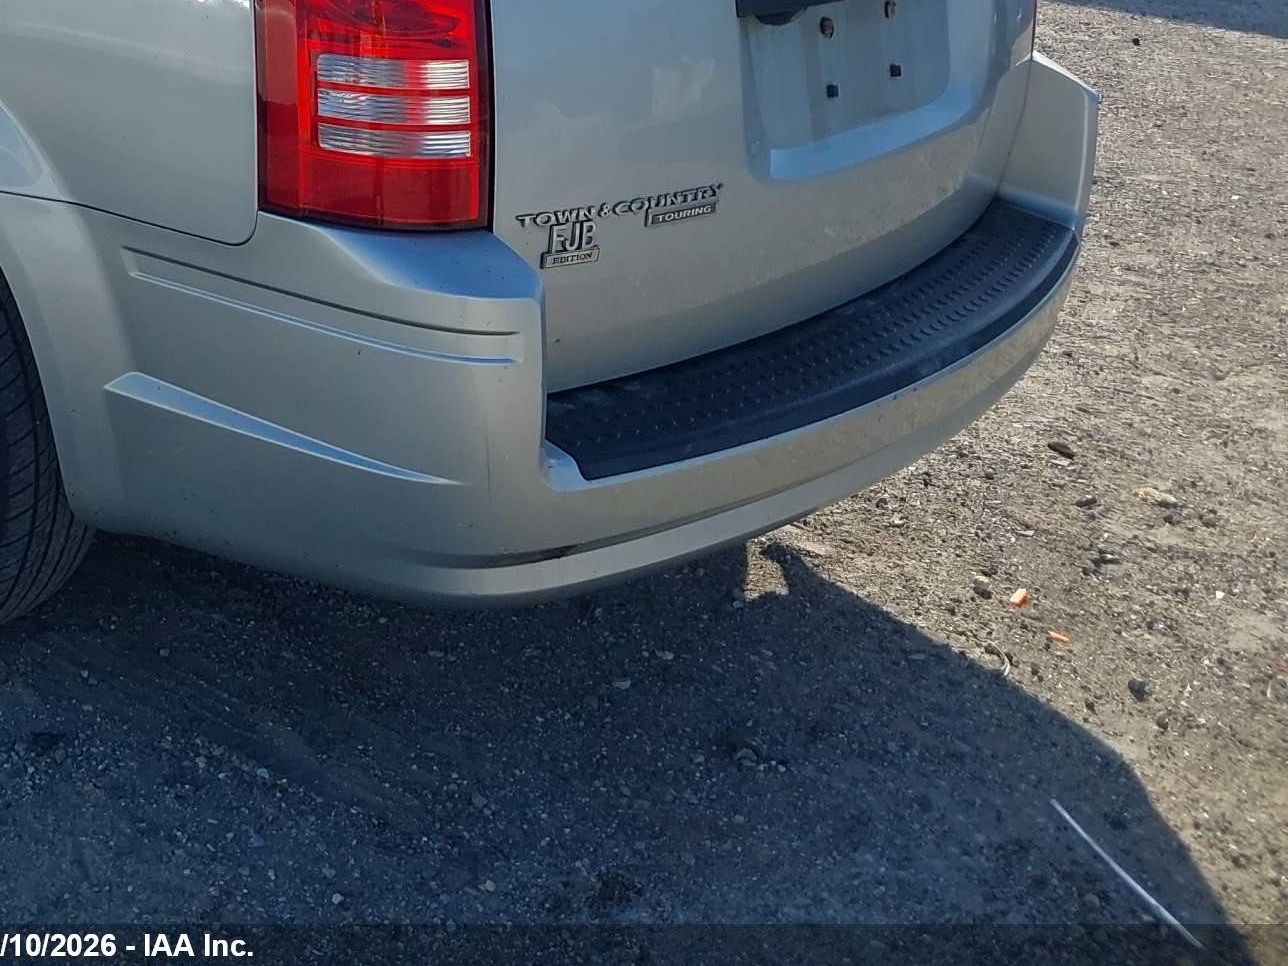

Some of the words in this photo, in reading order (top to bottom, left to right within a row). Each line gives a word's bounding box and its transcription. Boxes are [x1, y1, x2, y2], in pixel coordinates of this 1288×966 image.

[515, 205, 595, 228] TOWN
[598, 202, 612, 218] &
[611, 183, 724, 216] COUNTRY
[655, 205, 713, 223] TOURING
[548, 221, 597, 253] FJB
[552, 252, 593, 265] EDITION
